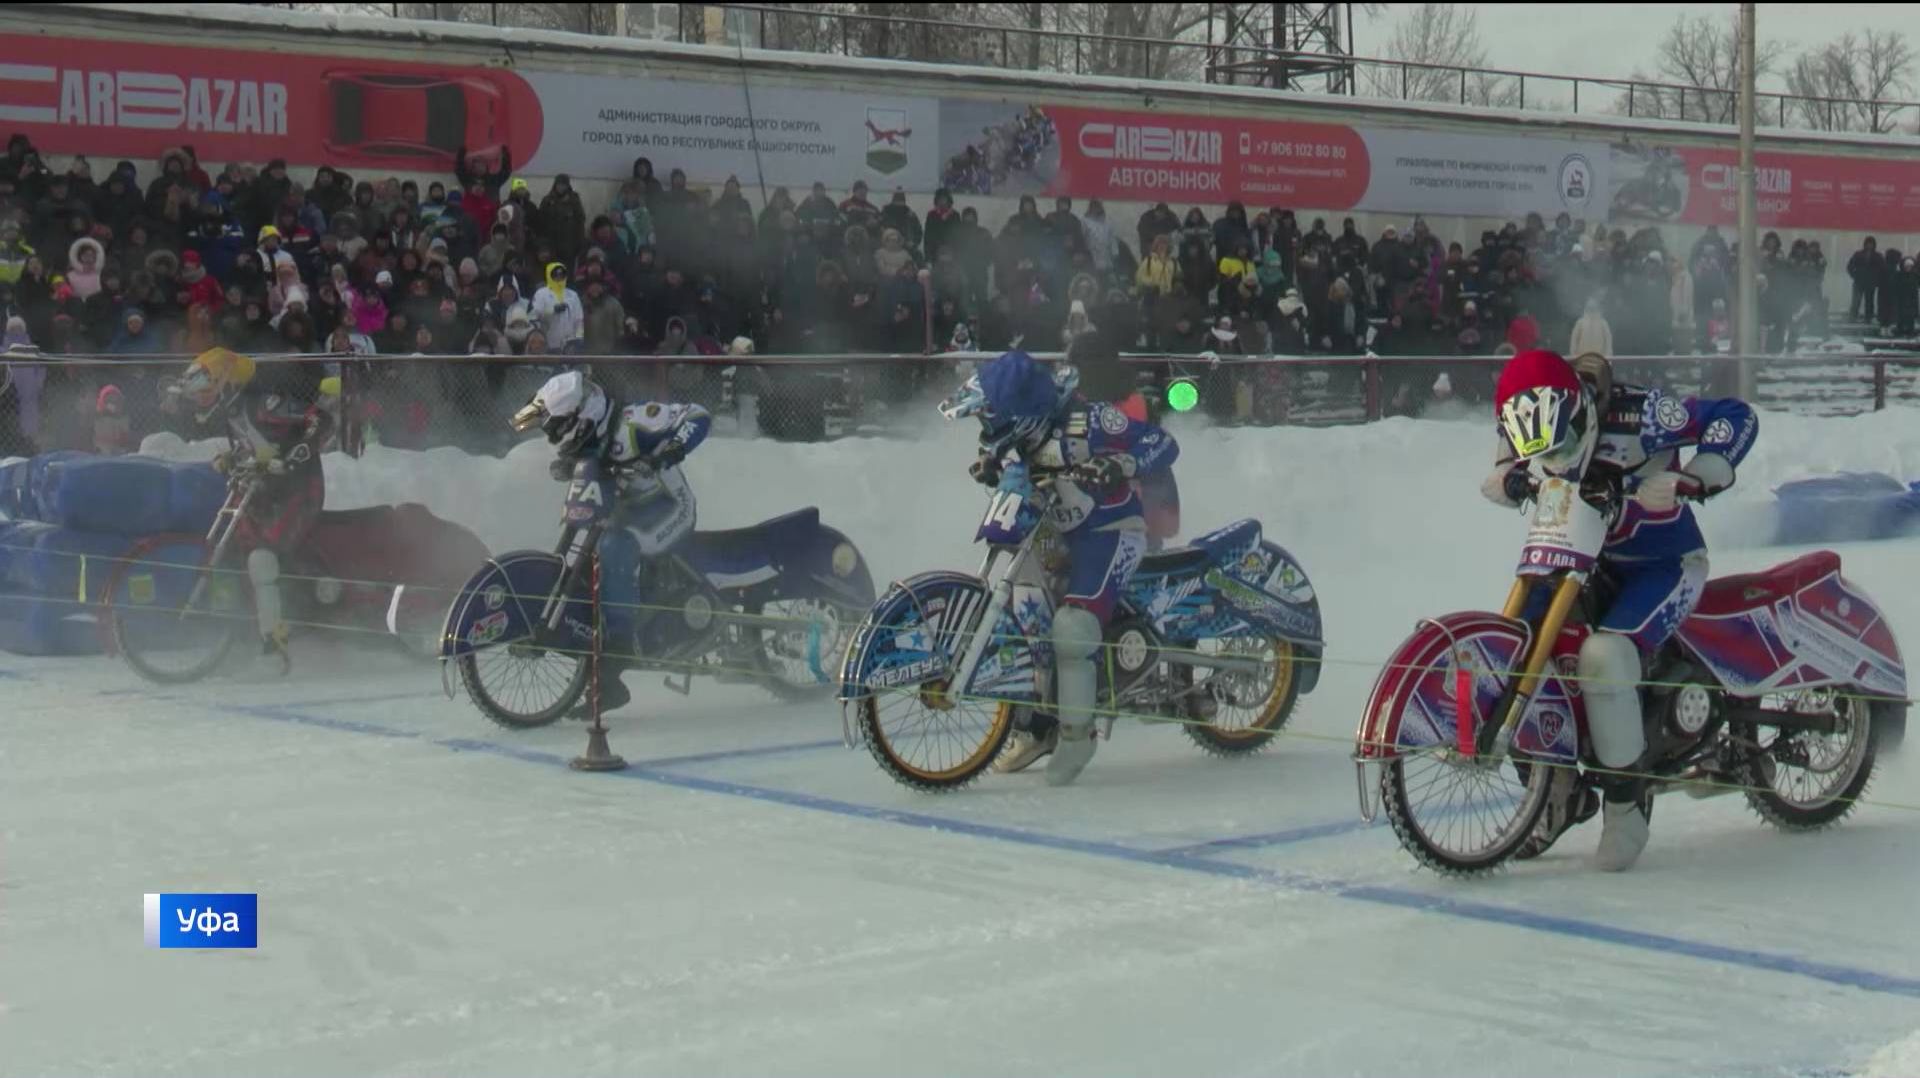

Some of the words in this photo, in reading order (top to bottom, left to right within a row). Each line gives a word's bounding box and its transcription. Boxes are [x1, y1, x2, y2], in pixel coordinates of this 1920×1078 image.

[597, 108, 702, 127] АДМИНИСТРАЦИЯ
[704, 115, 778, 131] ГОРОДСКОГО
[781, 120, 823, 134] ОКРУГА
[582, 132, 624, 147] ГОРОД
[625, 134, 650, 147] УФА
[652, 136, 670, 148] ПО
[671, 136, 746, 152] РЕСПУБЛИКЕ
[747, 140, 837, 156] БАШКОРТОСТАН
[1079, 123, 1223, 165] CARBAZAR
[1256, 141, 1269, 155] +7
[1295, 143, 1313, 158] 102
[1108, 167, 1222, 192] АВТОРЫНОК
[983, 490, 1024, 532] 14
